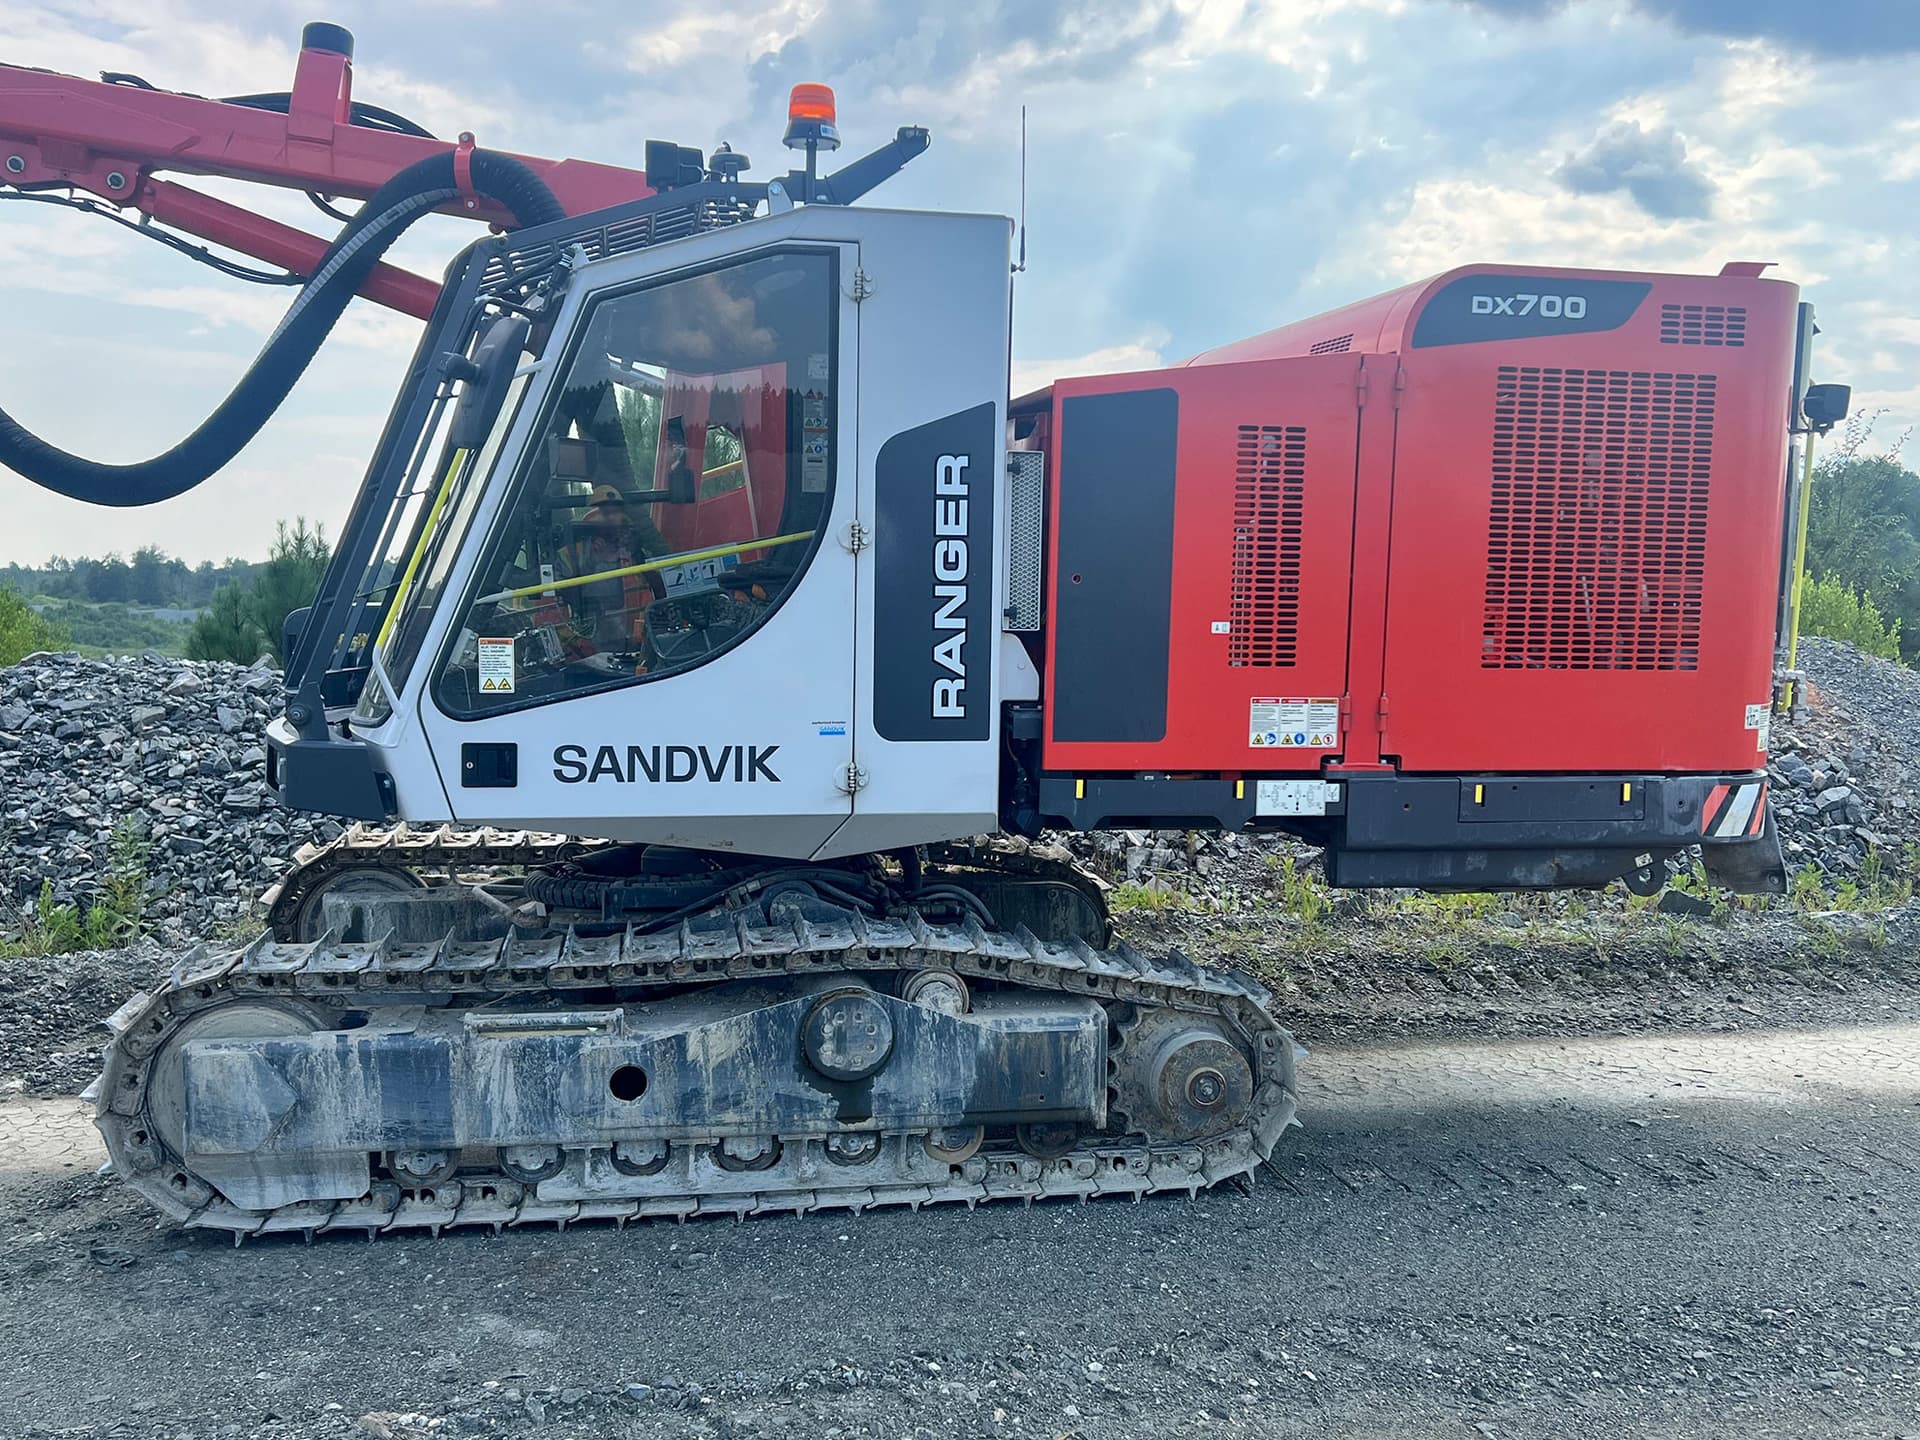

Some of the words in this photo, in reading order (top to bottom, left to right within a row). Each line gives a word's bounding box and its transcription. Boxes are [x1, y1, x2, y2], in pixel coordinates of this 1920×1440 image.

[1471, 294, 1587, 319] DX700
[932, 454, 969, 718] RANGER
[552, 744, 781, 783] SANDVIK
